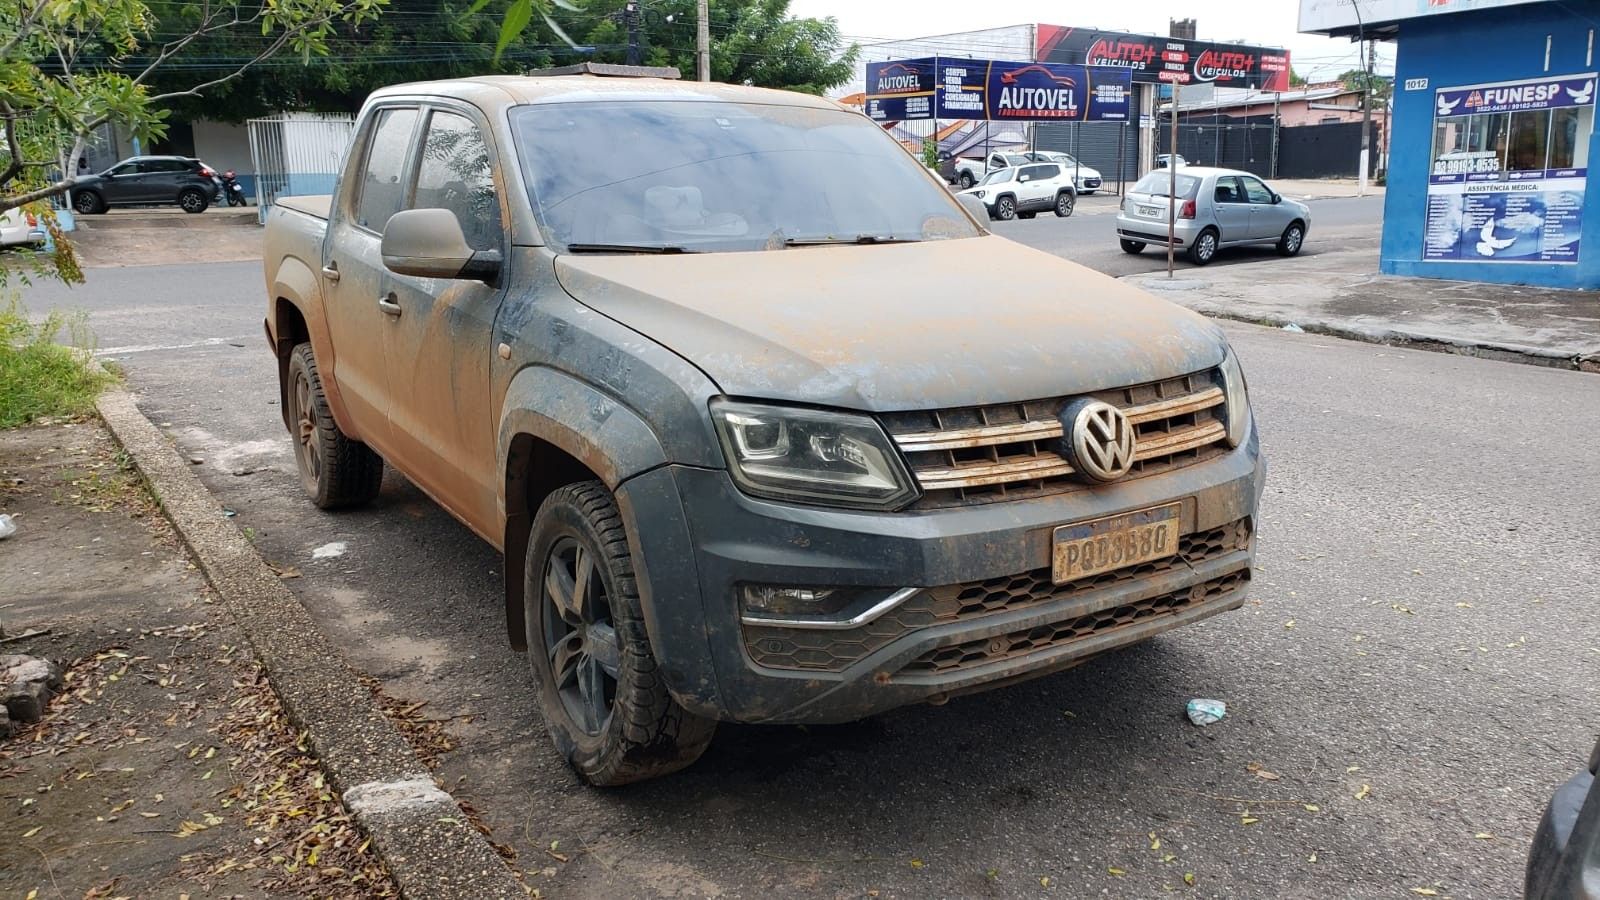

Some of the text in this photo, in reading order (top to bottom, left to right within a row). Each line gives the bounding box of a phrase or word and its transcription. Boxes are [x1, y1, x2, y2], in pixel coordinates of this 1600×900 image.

[1093, 40, 1156, 64] AUTO+
[1201, 50, 1254, 72] AUTO+
[878, 75, 920, 90] AUTOVEL
[1407, 79, 1427, 88] 1012
[998, 87, 1077, 110] AUTOVEL
[1483, 84, 1560, 105] FUNESP
